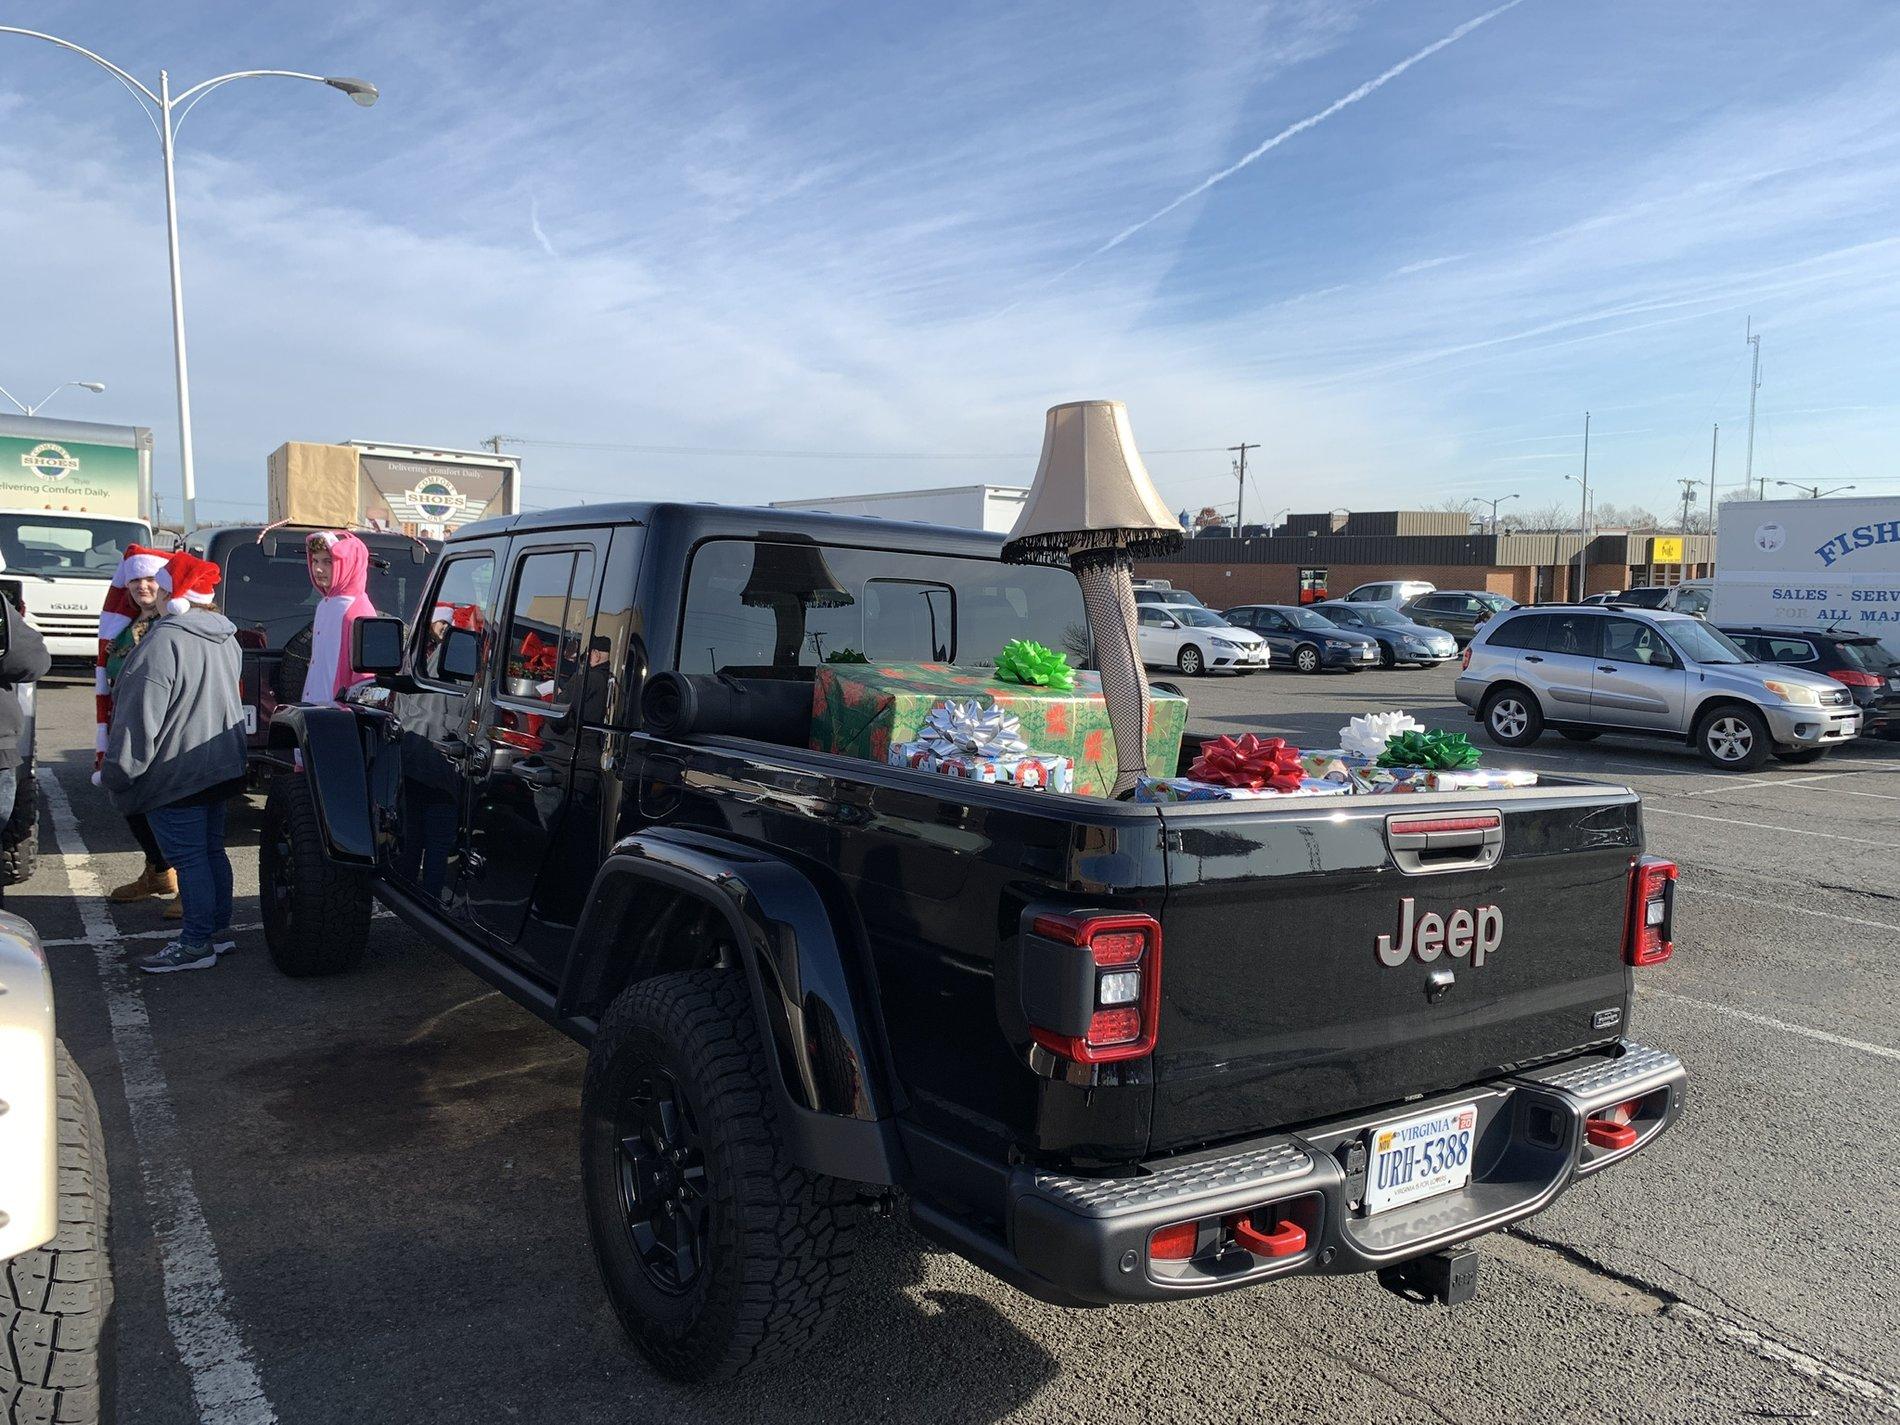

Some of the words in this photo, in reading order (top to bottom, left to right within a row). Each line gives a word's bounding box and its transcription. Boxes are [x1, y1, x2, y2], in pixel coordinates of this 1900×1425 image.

[23, 457, 78, 468] SHOES
[388, 463, 428, 473] Delivering
[429, 467, 461, 476] Comfort
[462, 470, 484, 479] Daily.
[41, 484, 82, 496] Comfort
[84, 487, 111, 499] Daily.
[408, 493, 465, 506] SHOES
[1772, 588, 1828, 601] SALES
[50, 603, 89, 611] ISUZU
[1775, 607, 1809, 619] FOR
[1816, 609, 1852, 621] ALL
[1860, 610, 1900, 622] MAJ
[1375, 897, 1503, 968] Jeep
[1401, 1118, 1450, 1141] VIRGINIA
[1461, 1119, 1472, 1129] 20
[1379, 1140, 1392, 1151] NOV
[1377, 1130, 1470, 1190] URH-5388
